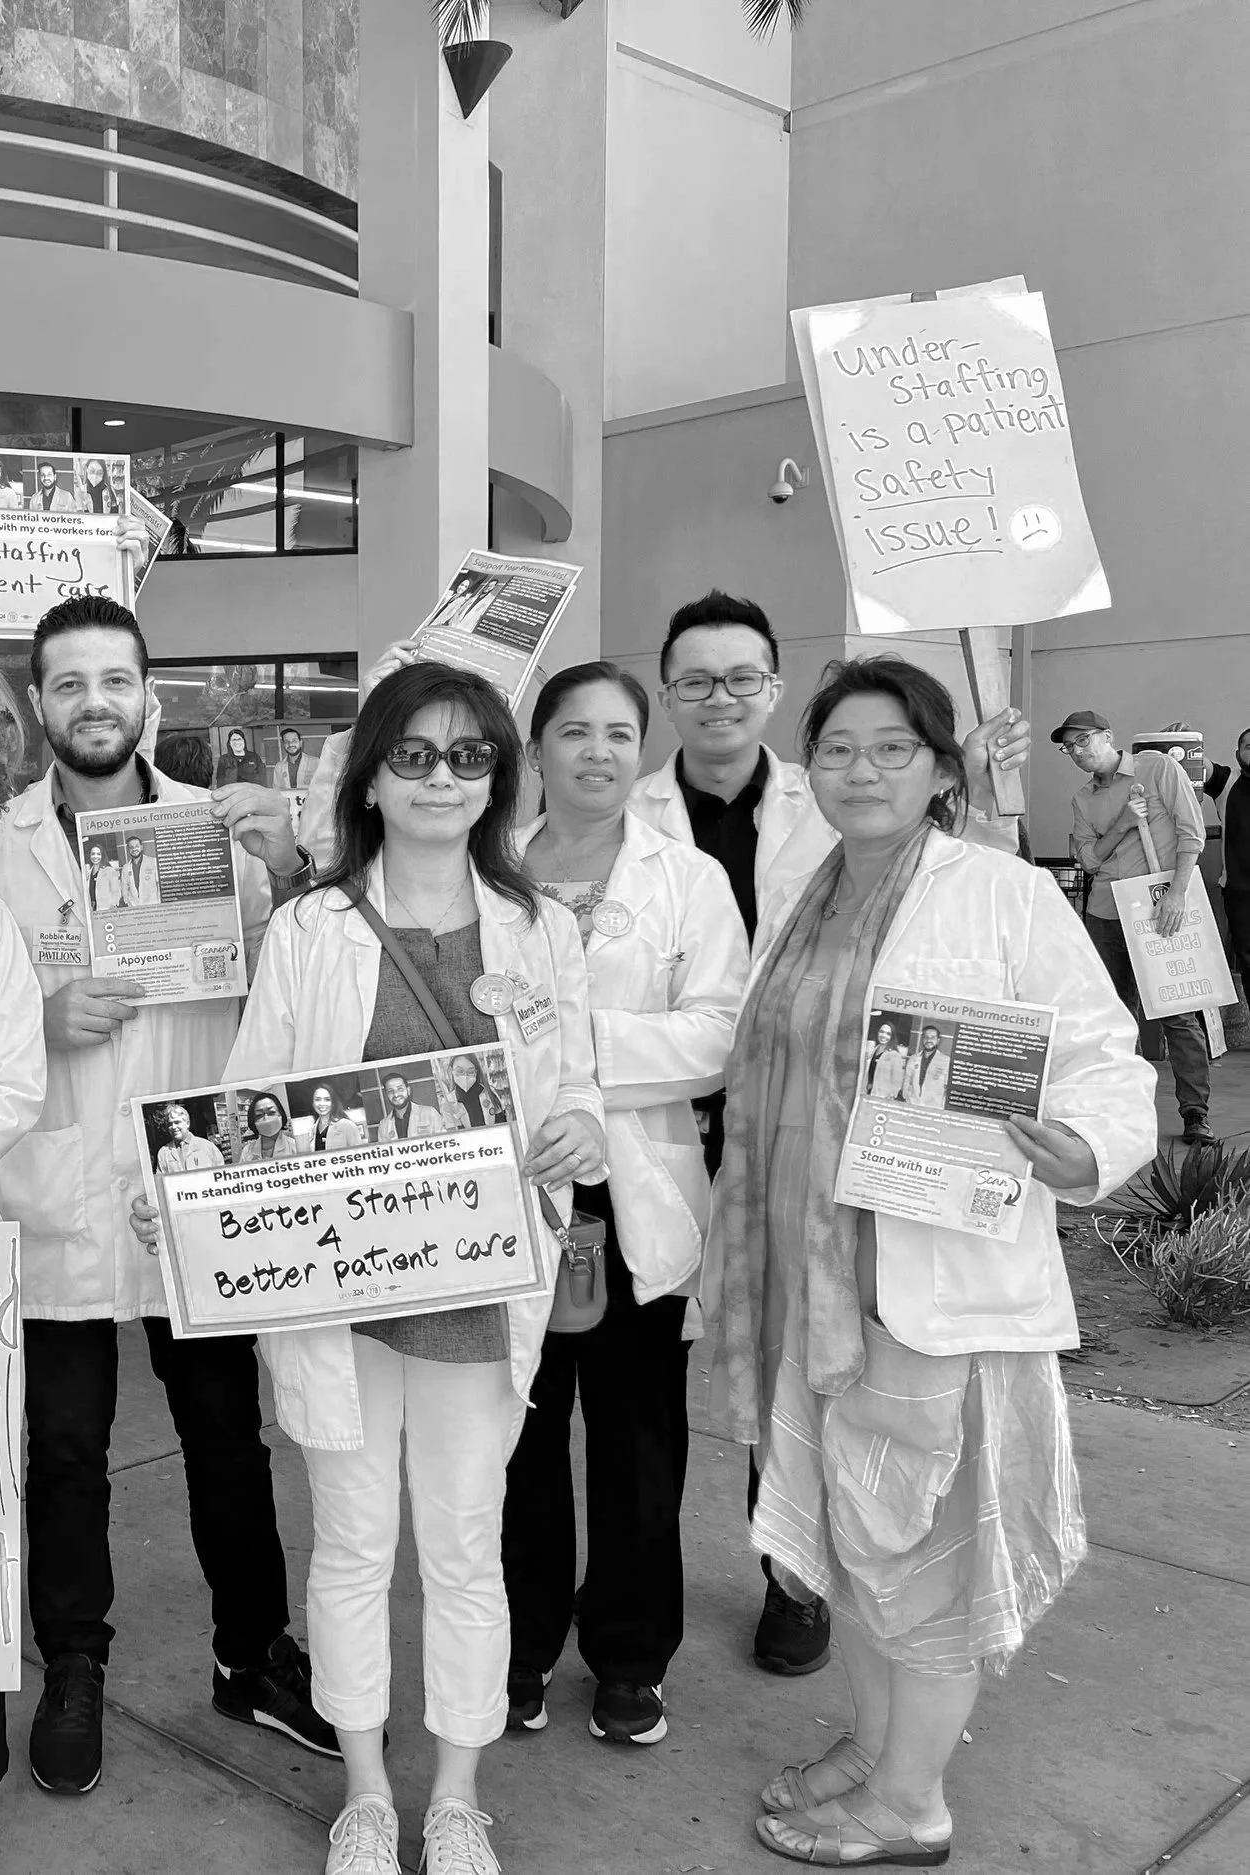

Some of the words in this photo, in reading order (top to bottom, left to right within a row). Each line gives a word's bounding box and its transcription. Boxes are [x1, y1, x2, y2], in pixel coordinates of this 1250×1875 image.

[841, 423, 890, 452] is
[906, 421, 932, 445] a
[942, 395, 1066, 445] patient
[20, 525, 36, 535] my
[37, 525, 93, 536] co-workers
[95, 528, 113, 536] for:
[41, 515, 85, 525] workers.
[132, 815, 148, 824] sus
[39, 932, 65, 940] Robbie
[38, 951, 82, 963] PAVILIONS
[117, 952, 172, 967] ¡Apóyenos!
[883, 993, 928, 1010] Support
[932, 1001, 959, 1015] Your
[962, 1006, 1040, 1028] Pharmacists!
[176, 1190, 198, 1201] I'm
[201, 1180, 263, 1199] standing
[266, 1171, 328, 1191] together
[332, 1165, 365, 1180] with
[368, 1163, 391, 1177] my
[394, 1150, 475, 1171] co-workers
[479, 1146, 504, 1159] for:
[213, 1161, 300, 1183] Pharmacists
[304, 1158, 327, 1168] are
[330, 1146, 394, 1165] essential
[397, 1138, 460, 1155] workers.
[860, 1150, 896, 1166] Stand
[897, 1159, 922, 1173] with
[925, 1165, 943, 1177] us!
[975, 1170, 1009, 1188] Scan
[219, 1201, 324, 1240] Better
[316, 1223, 343, 1254] 4
[213, 1258, 317, 1299] Better
[334, 1240, 438, 1289] patient
